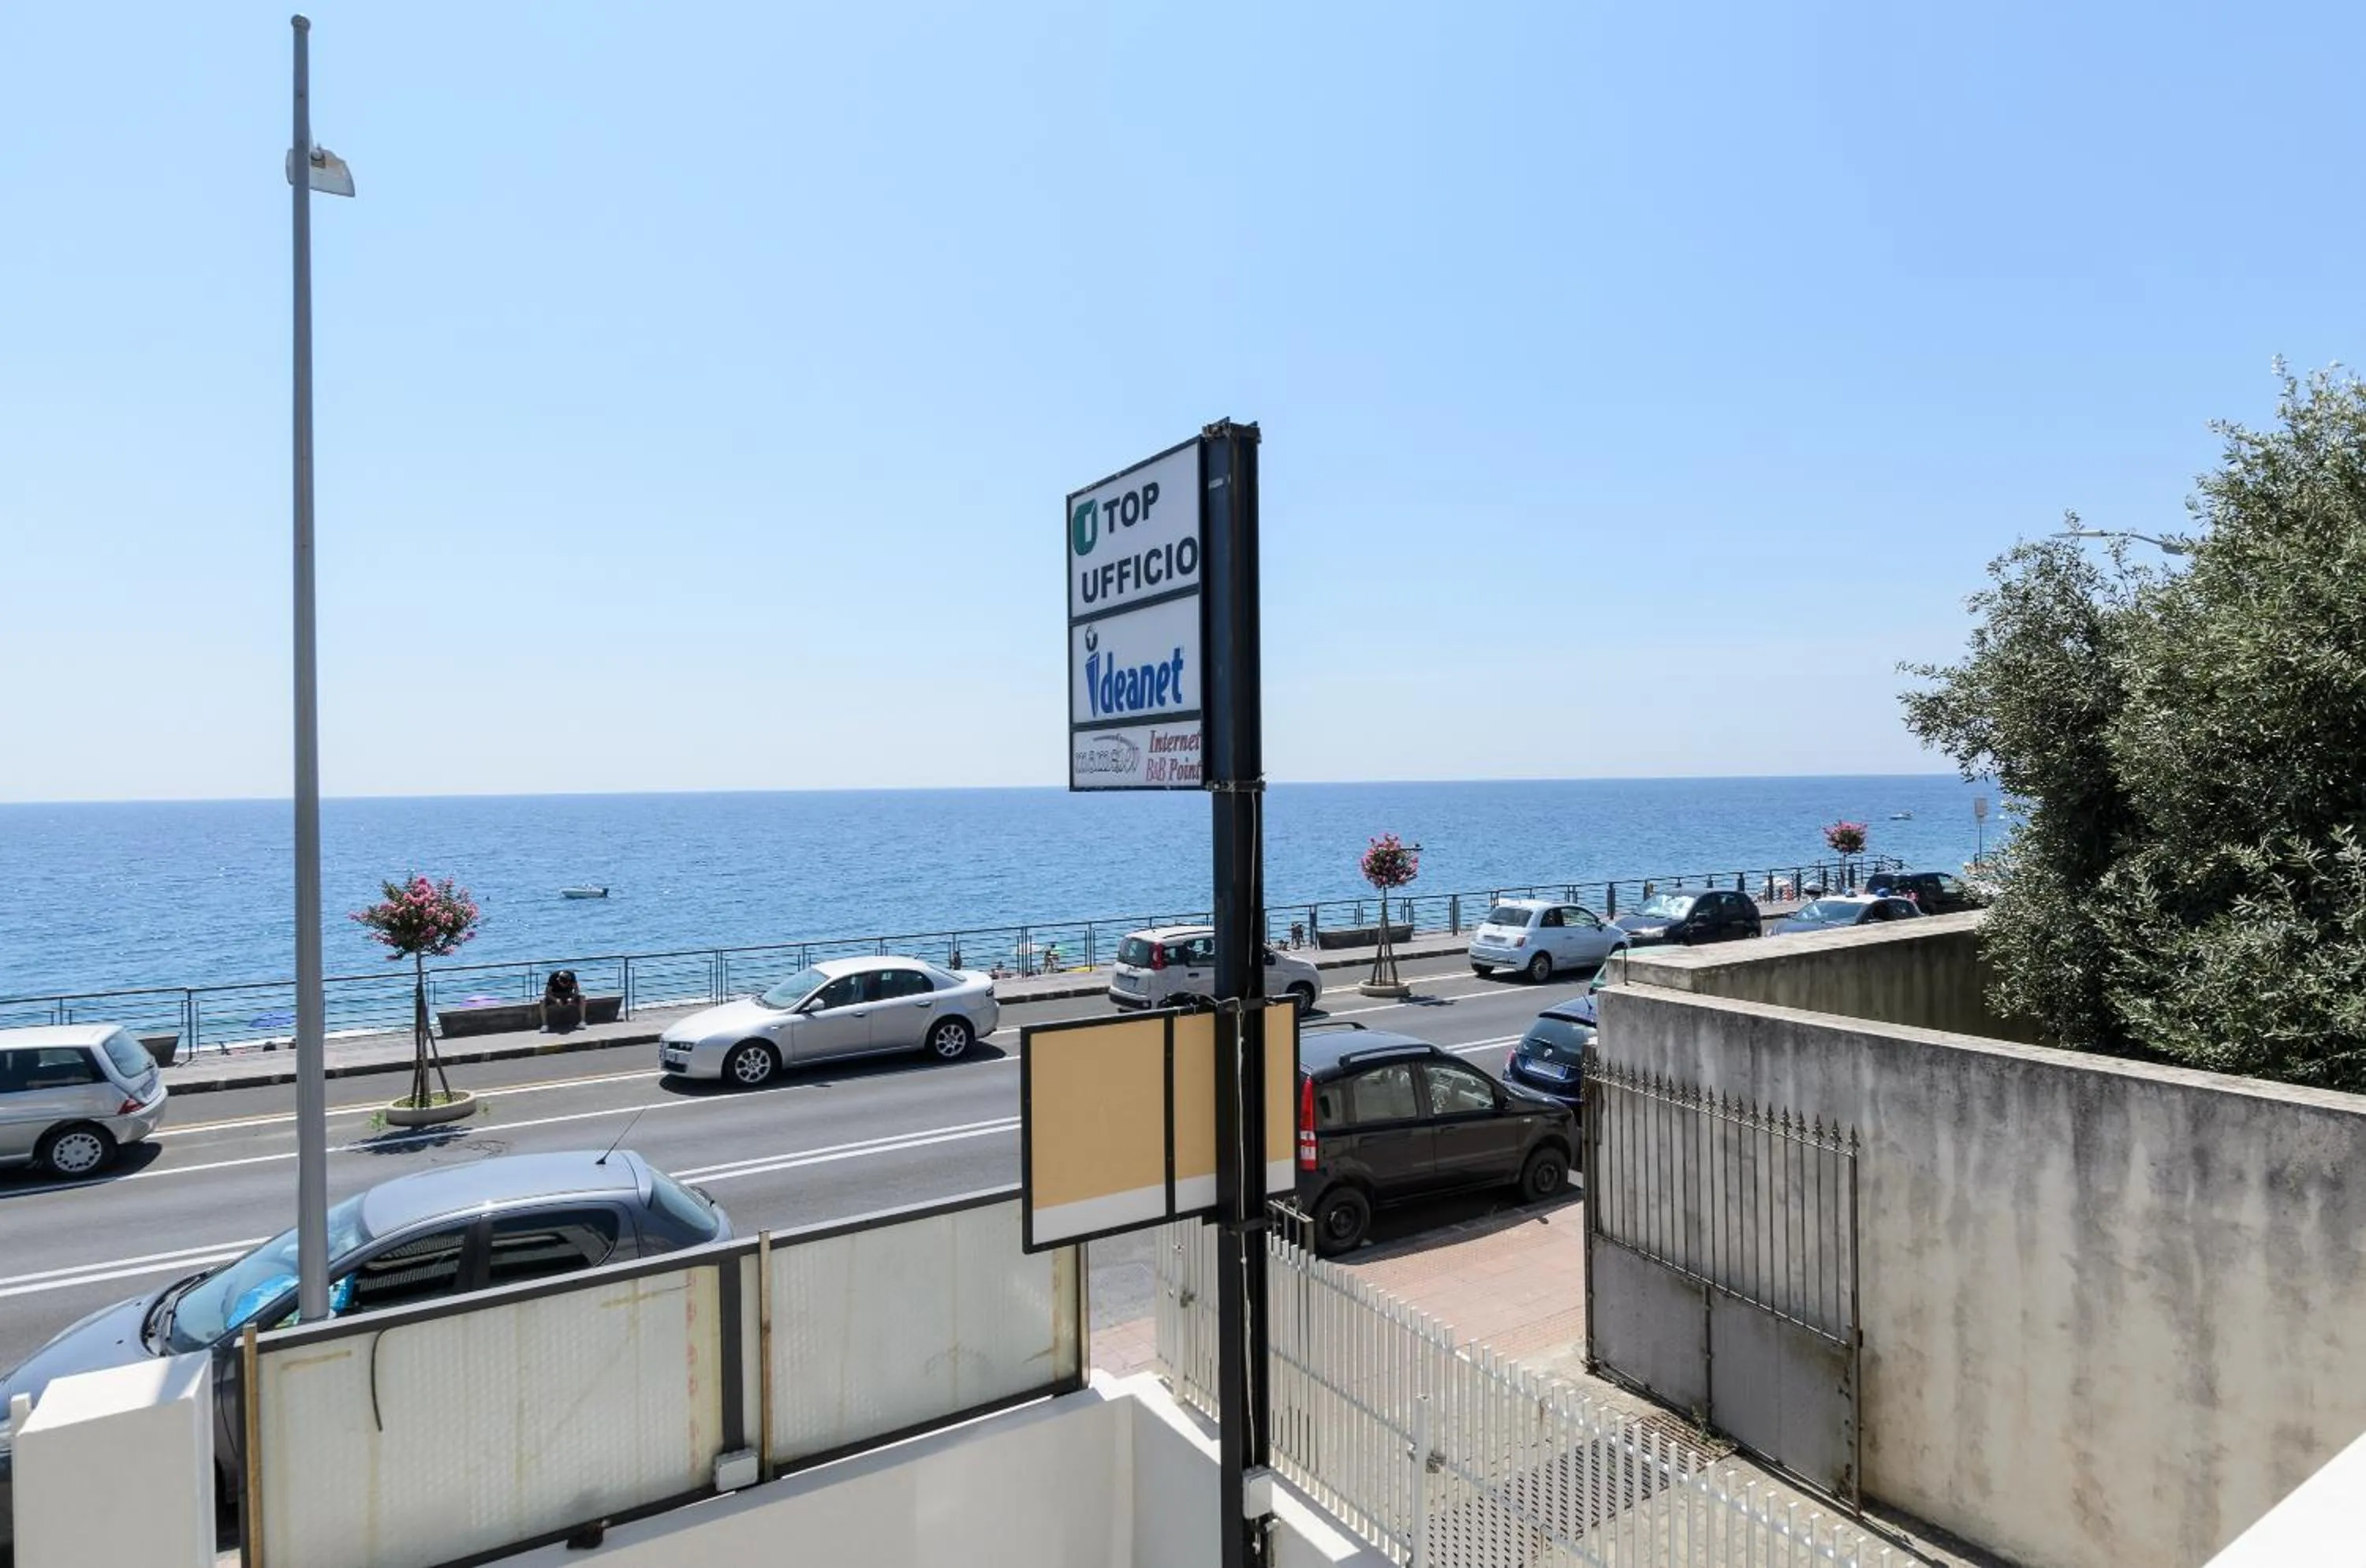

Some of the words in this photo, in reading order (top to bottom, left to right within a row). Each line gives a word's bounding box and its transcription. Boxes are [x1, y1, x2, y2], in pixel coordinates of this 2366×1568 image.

[1103, 482, 1159, 534] TOP
[1081, 536, 1198, 603] UFFICIO
[1148, 730, 1201, 752] Internet
[1169, 757, 1201, 781] Point
